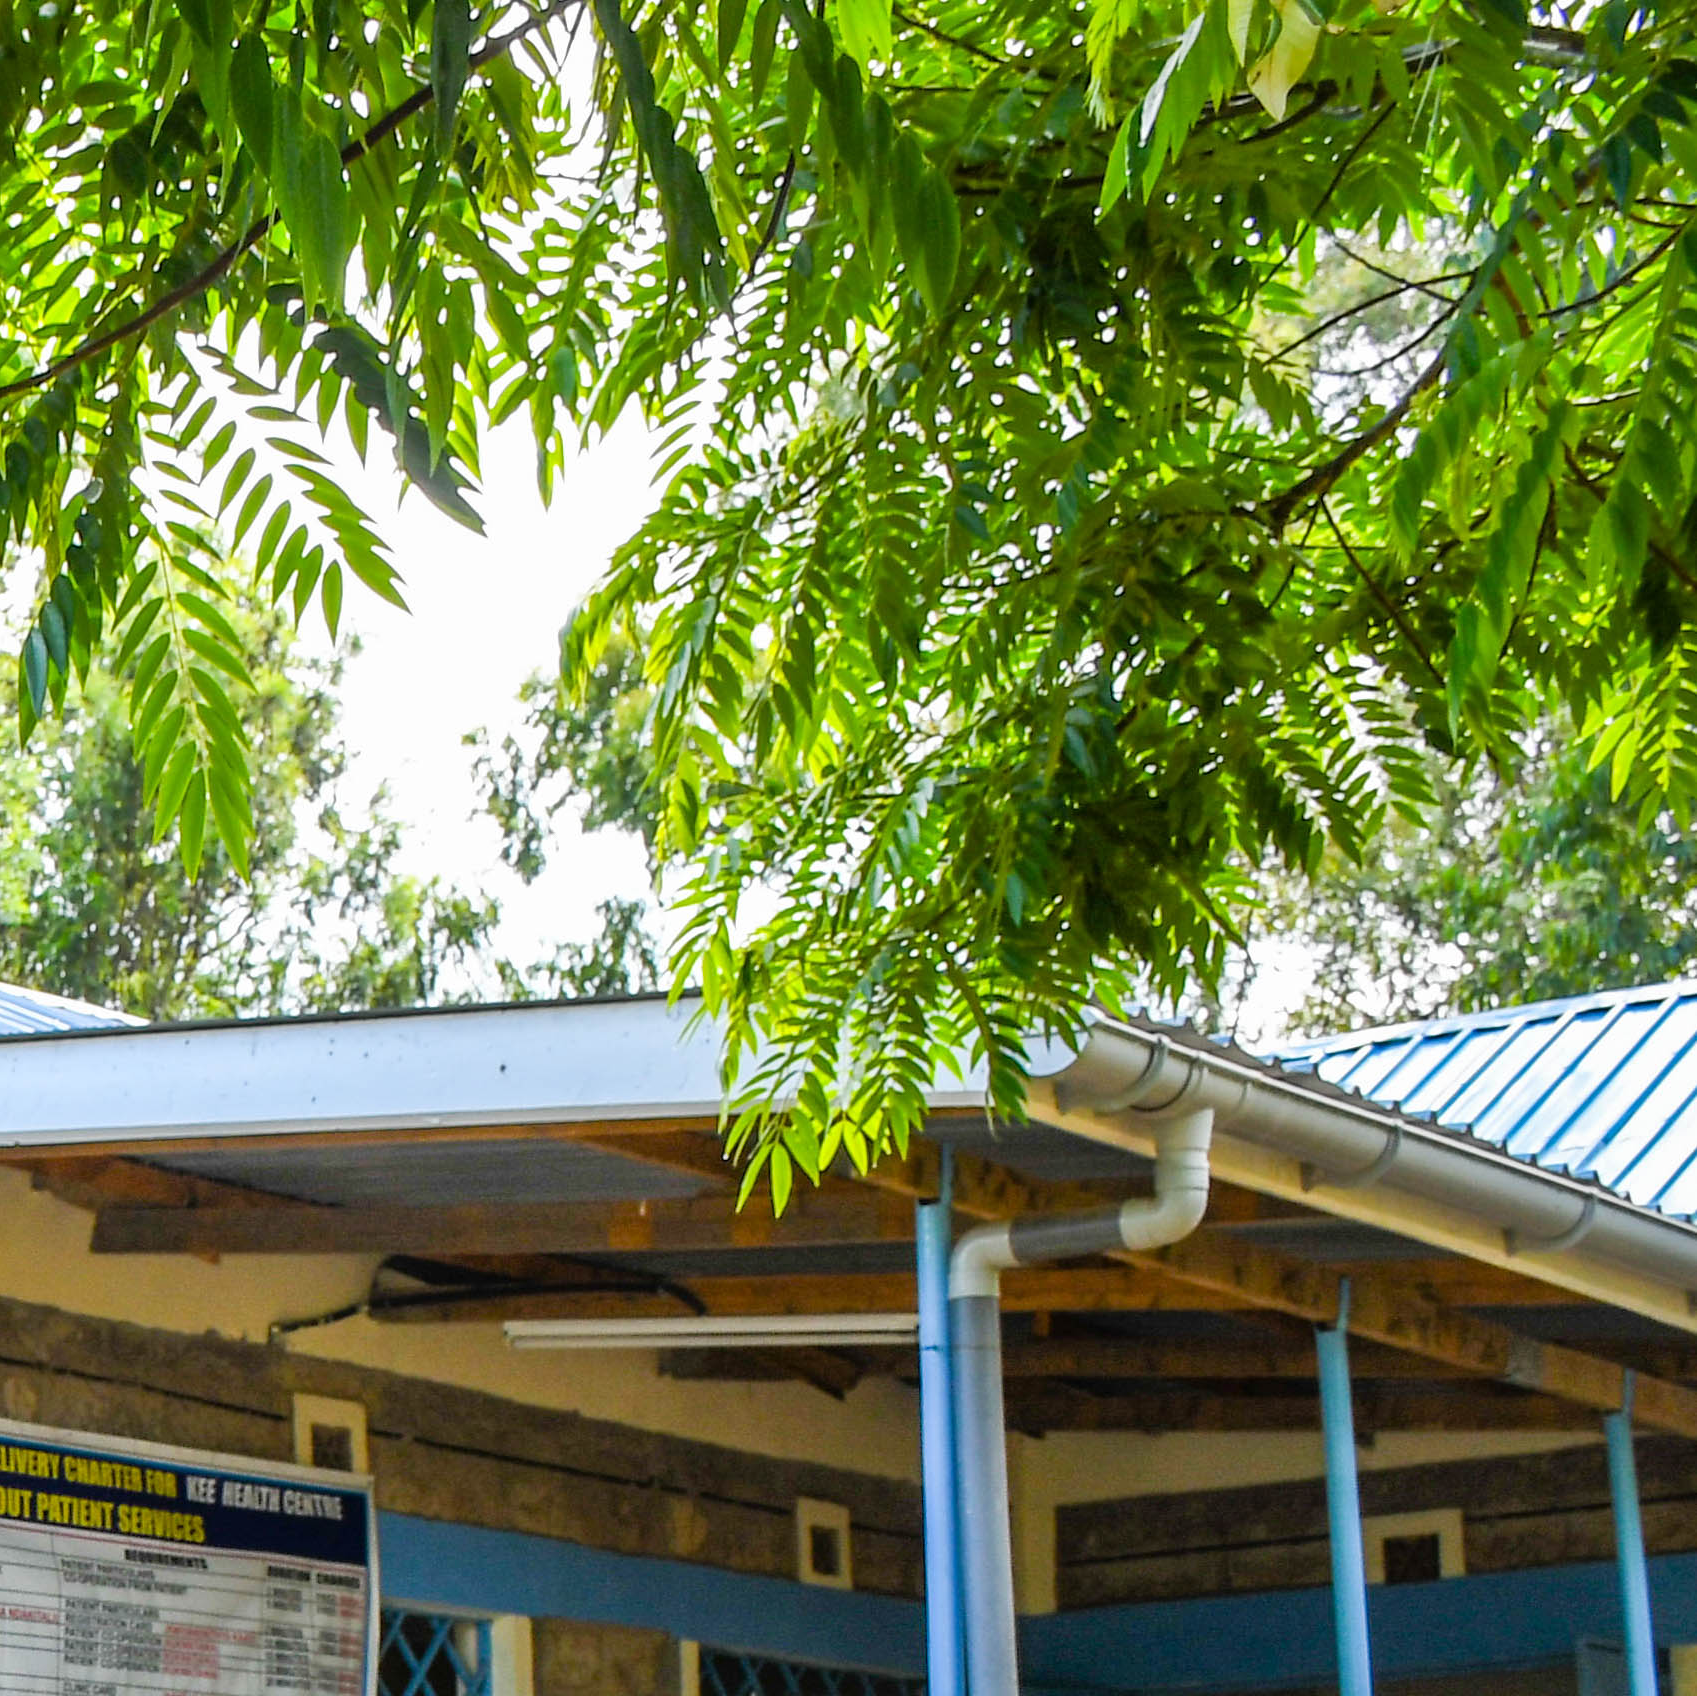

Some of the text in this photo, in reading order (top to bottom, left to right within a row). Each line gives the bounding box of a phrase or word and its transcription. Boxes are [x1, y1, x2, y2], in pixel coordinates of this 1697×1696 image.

[36, 1491, 114, 1529] PATIENT
[118, 1504, 205, 1543] SERVICES
[64, 1456, 143, 1493] CHARTER
[146, 1469, 177, 1498] FOR
[186, 1476, 218, 1504] KEE
[222, 1480, 280, 1512] HEALTH
[283, 1490, 343, 1520] CENTRE
